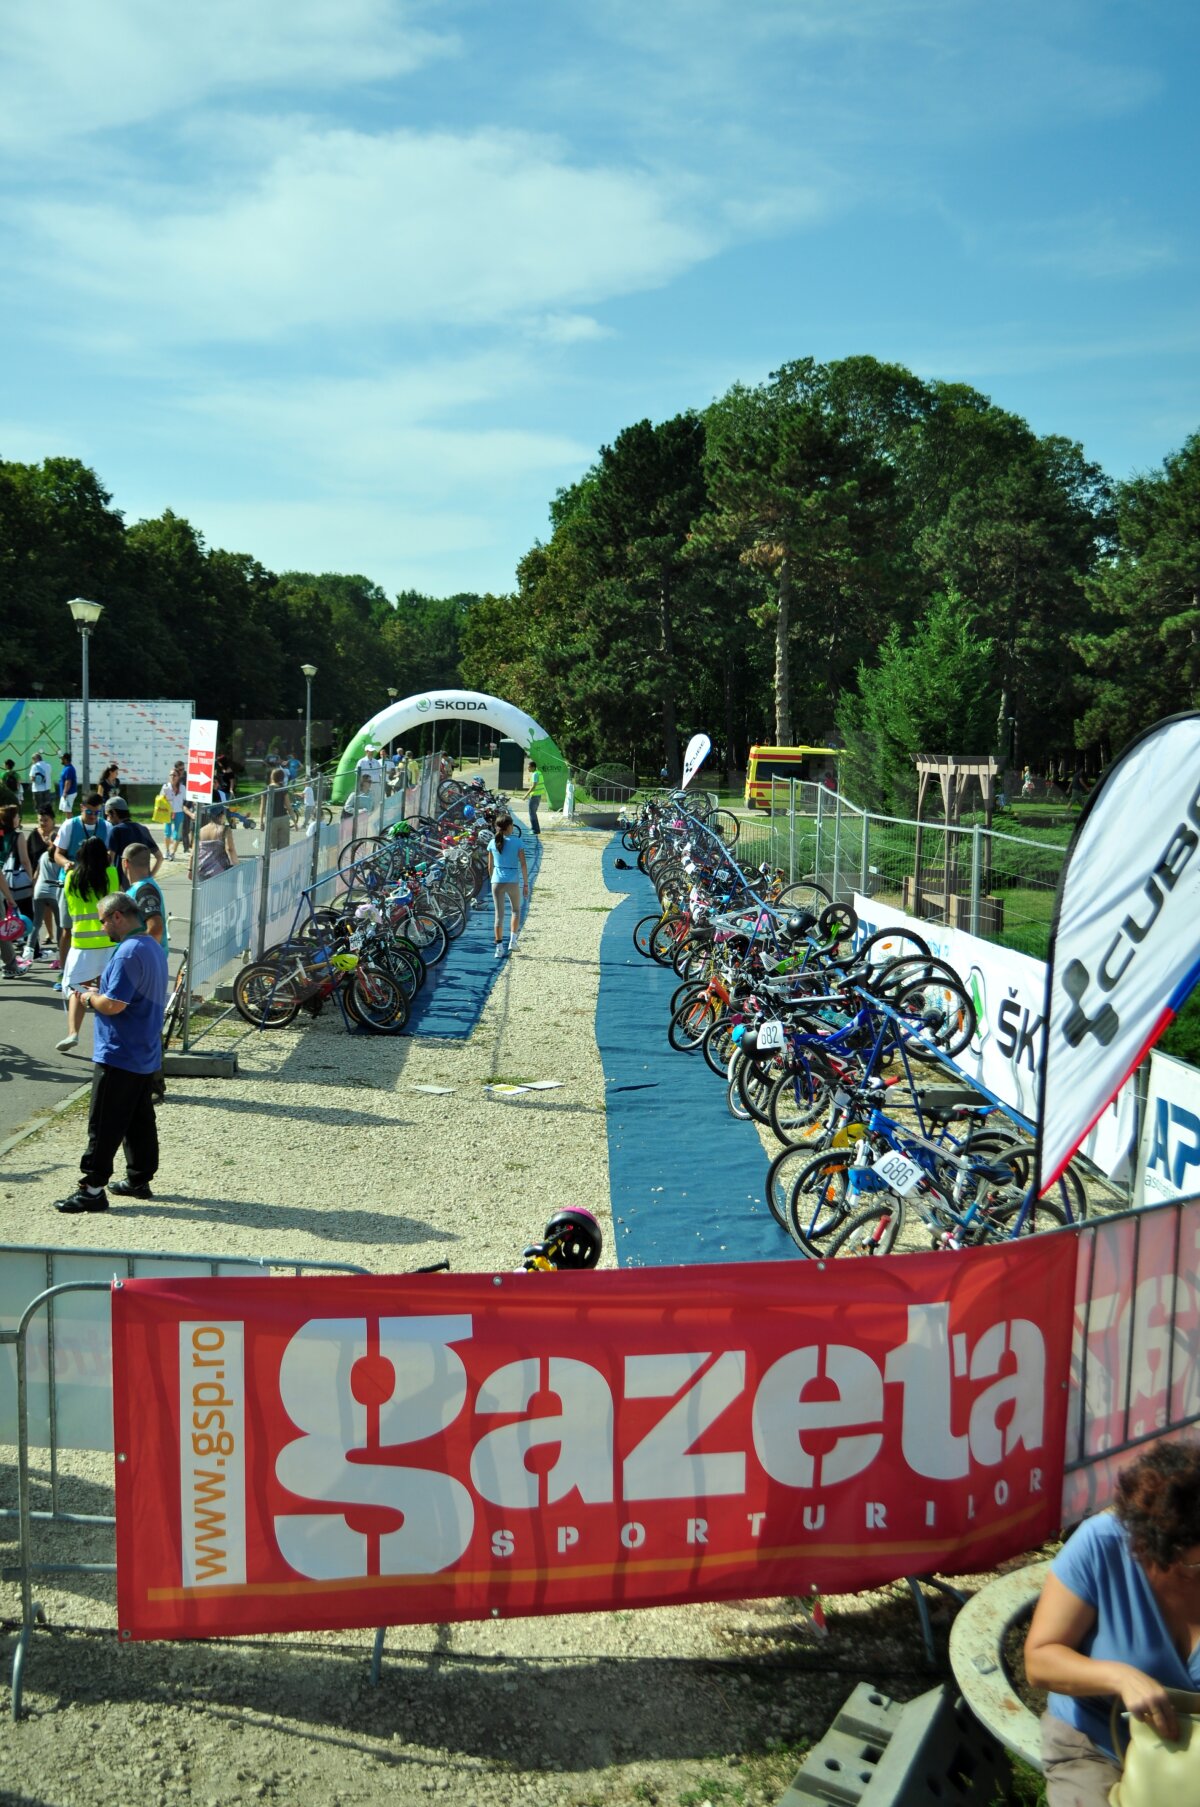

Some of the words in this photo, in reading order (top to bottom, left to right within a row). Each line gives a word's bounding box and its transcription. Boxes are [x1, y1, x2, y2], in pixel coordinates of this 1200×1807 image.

[435, 698, 488, 711] ŠKODA
[882, 1156, 914, 1187] 686
[191, 1325, 235, 1582] www.gsp.ro
[274, 1302, 1047, 1583] gazeta
